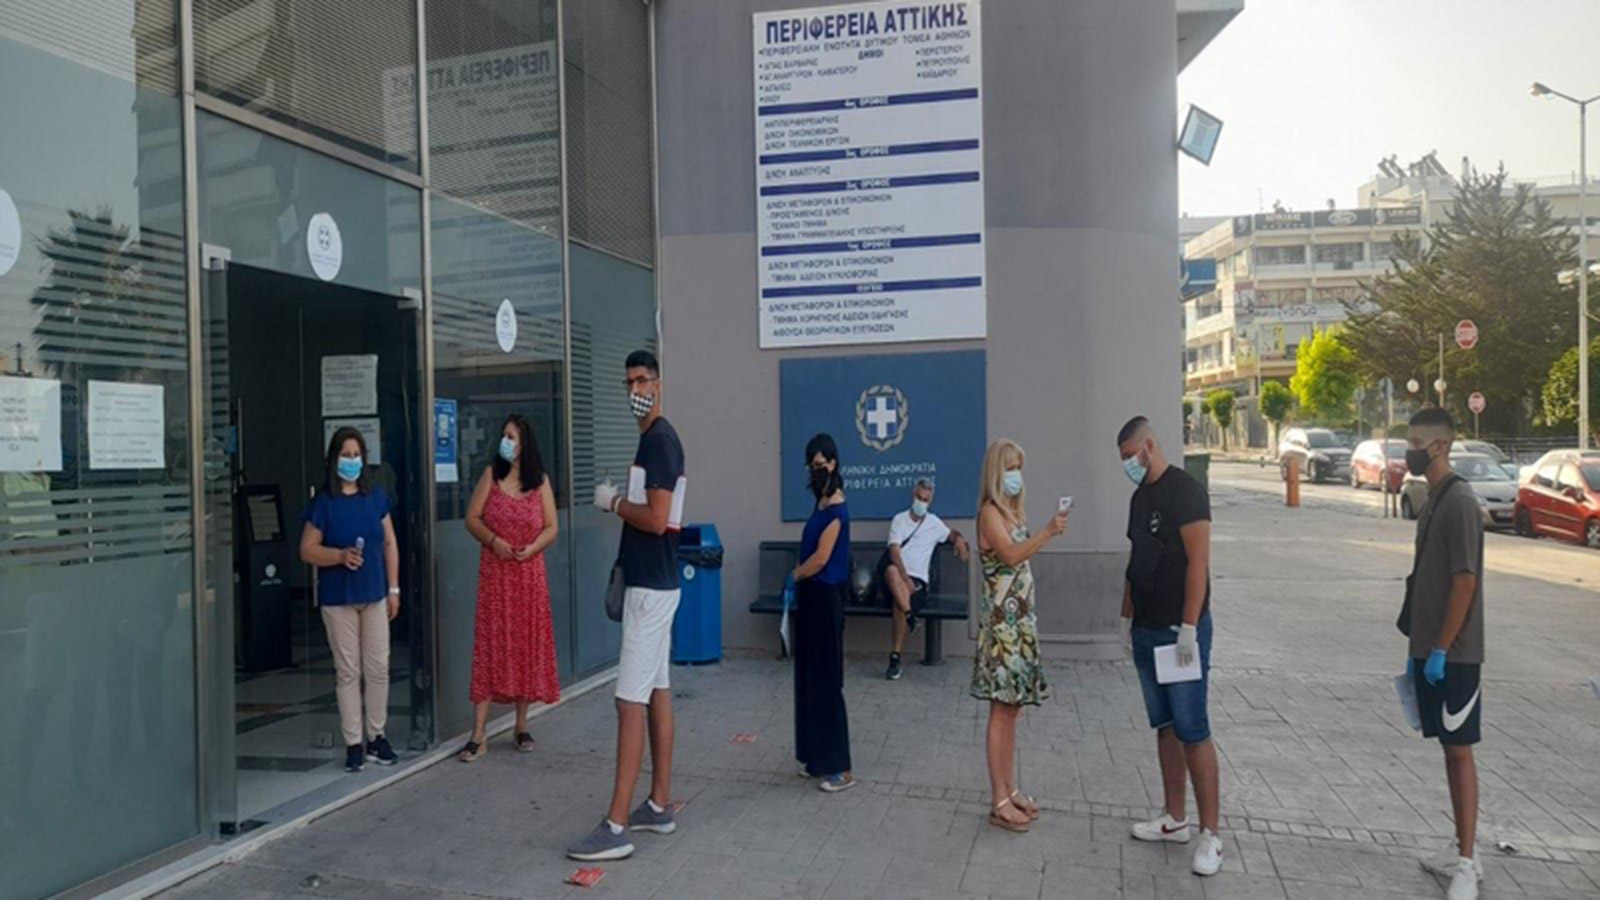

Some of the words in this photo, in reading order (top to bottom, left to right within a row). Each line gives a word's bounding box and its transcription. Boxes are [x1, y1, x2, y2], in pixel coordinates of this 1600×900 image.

[766, 11, 878, 44] ΠΕΡΙΦΕΡΕΙΑ
[884, 2, 967, 33] ΑΤΤΙΚΗΣ
[823, 40, 861, 52] ΕΝΟΤΗΤΑ
[864, 36, 898, 48] ΔΥΤΙΚΟΥ
[902, 33, 931, 44] ΤΟΜΕΑ
[934, 29, 971, 41] ΑΘΗΝΩΝ
[789, 139, 824, 149] ΤΕΧΝΙΚΩΝ
[826, 137, 850, 147] ΕΡΓΩΝ
[879, 462, 936, 475] ΔΗΜΟΚΡΑΤΙΑ
